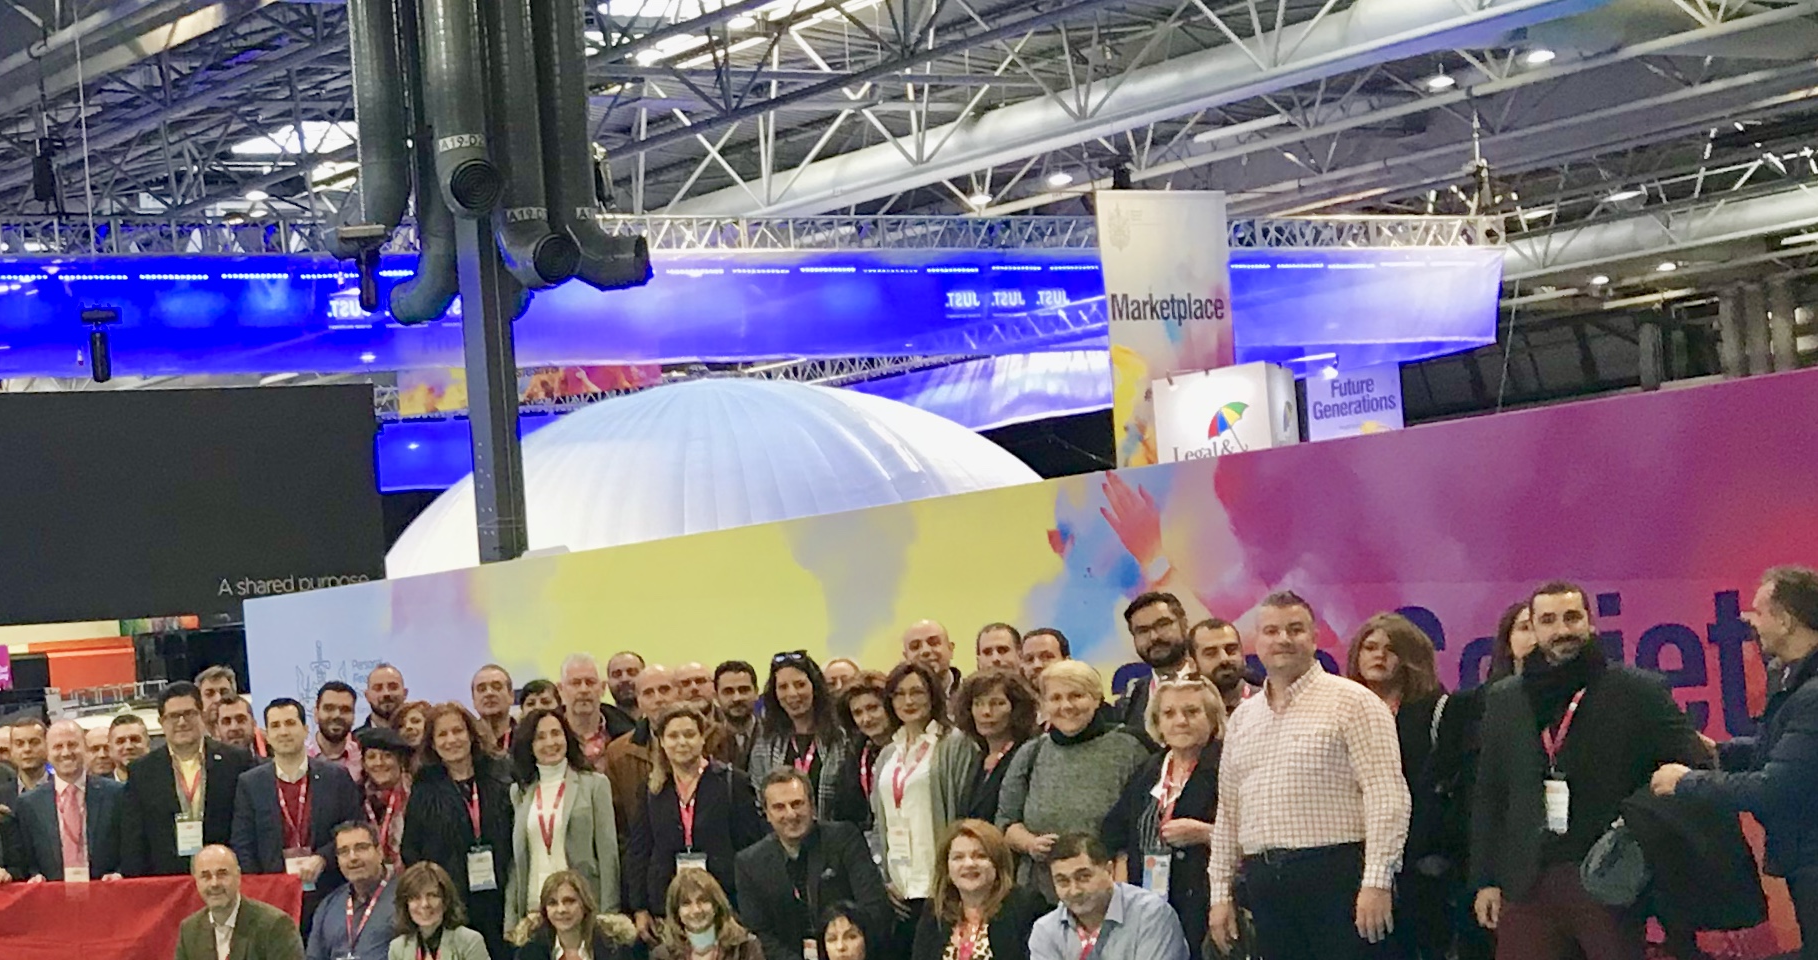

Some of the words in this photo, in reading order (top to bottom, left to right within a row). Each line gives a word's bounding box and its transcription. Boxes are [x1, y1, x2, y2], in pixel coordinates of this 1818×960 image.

[1110, 293, 1225, 326] Marketplace
[1331, 377, 1375, 399] Future
[1312, 394, 1397, 421] Generations
[218, 578, 233, 596] A
[237, 574, 294, 596] shared
